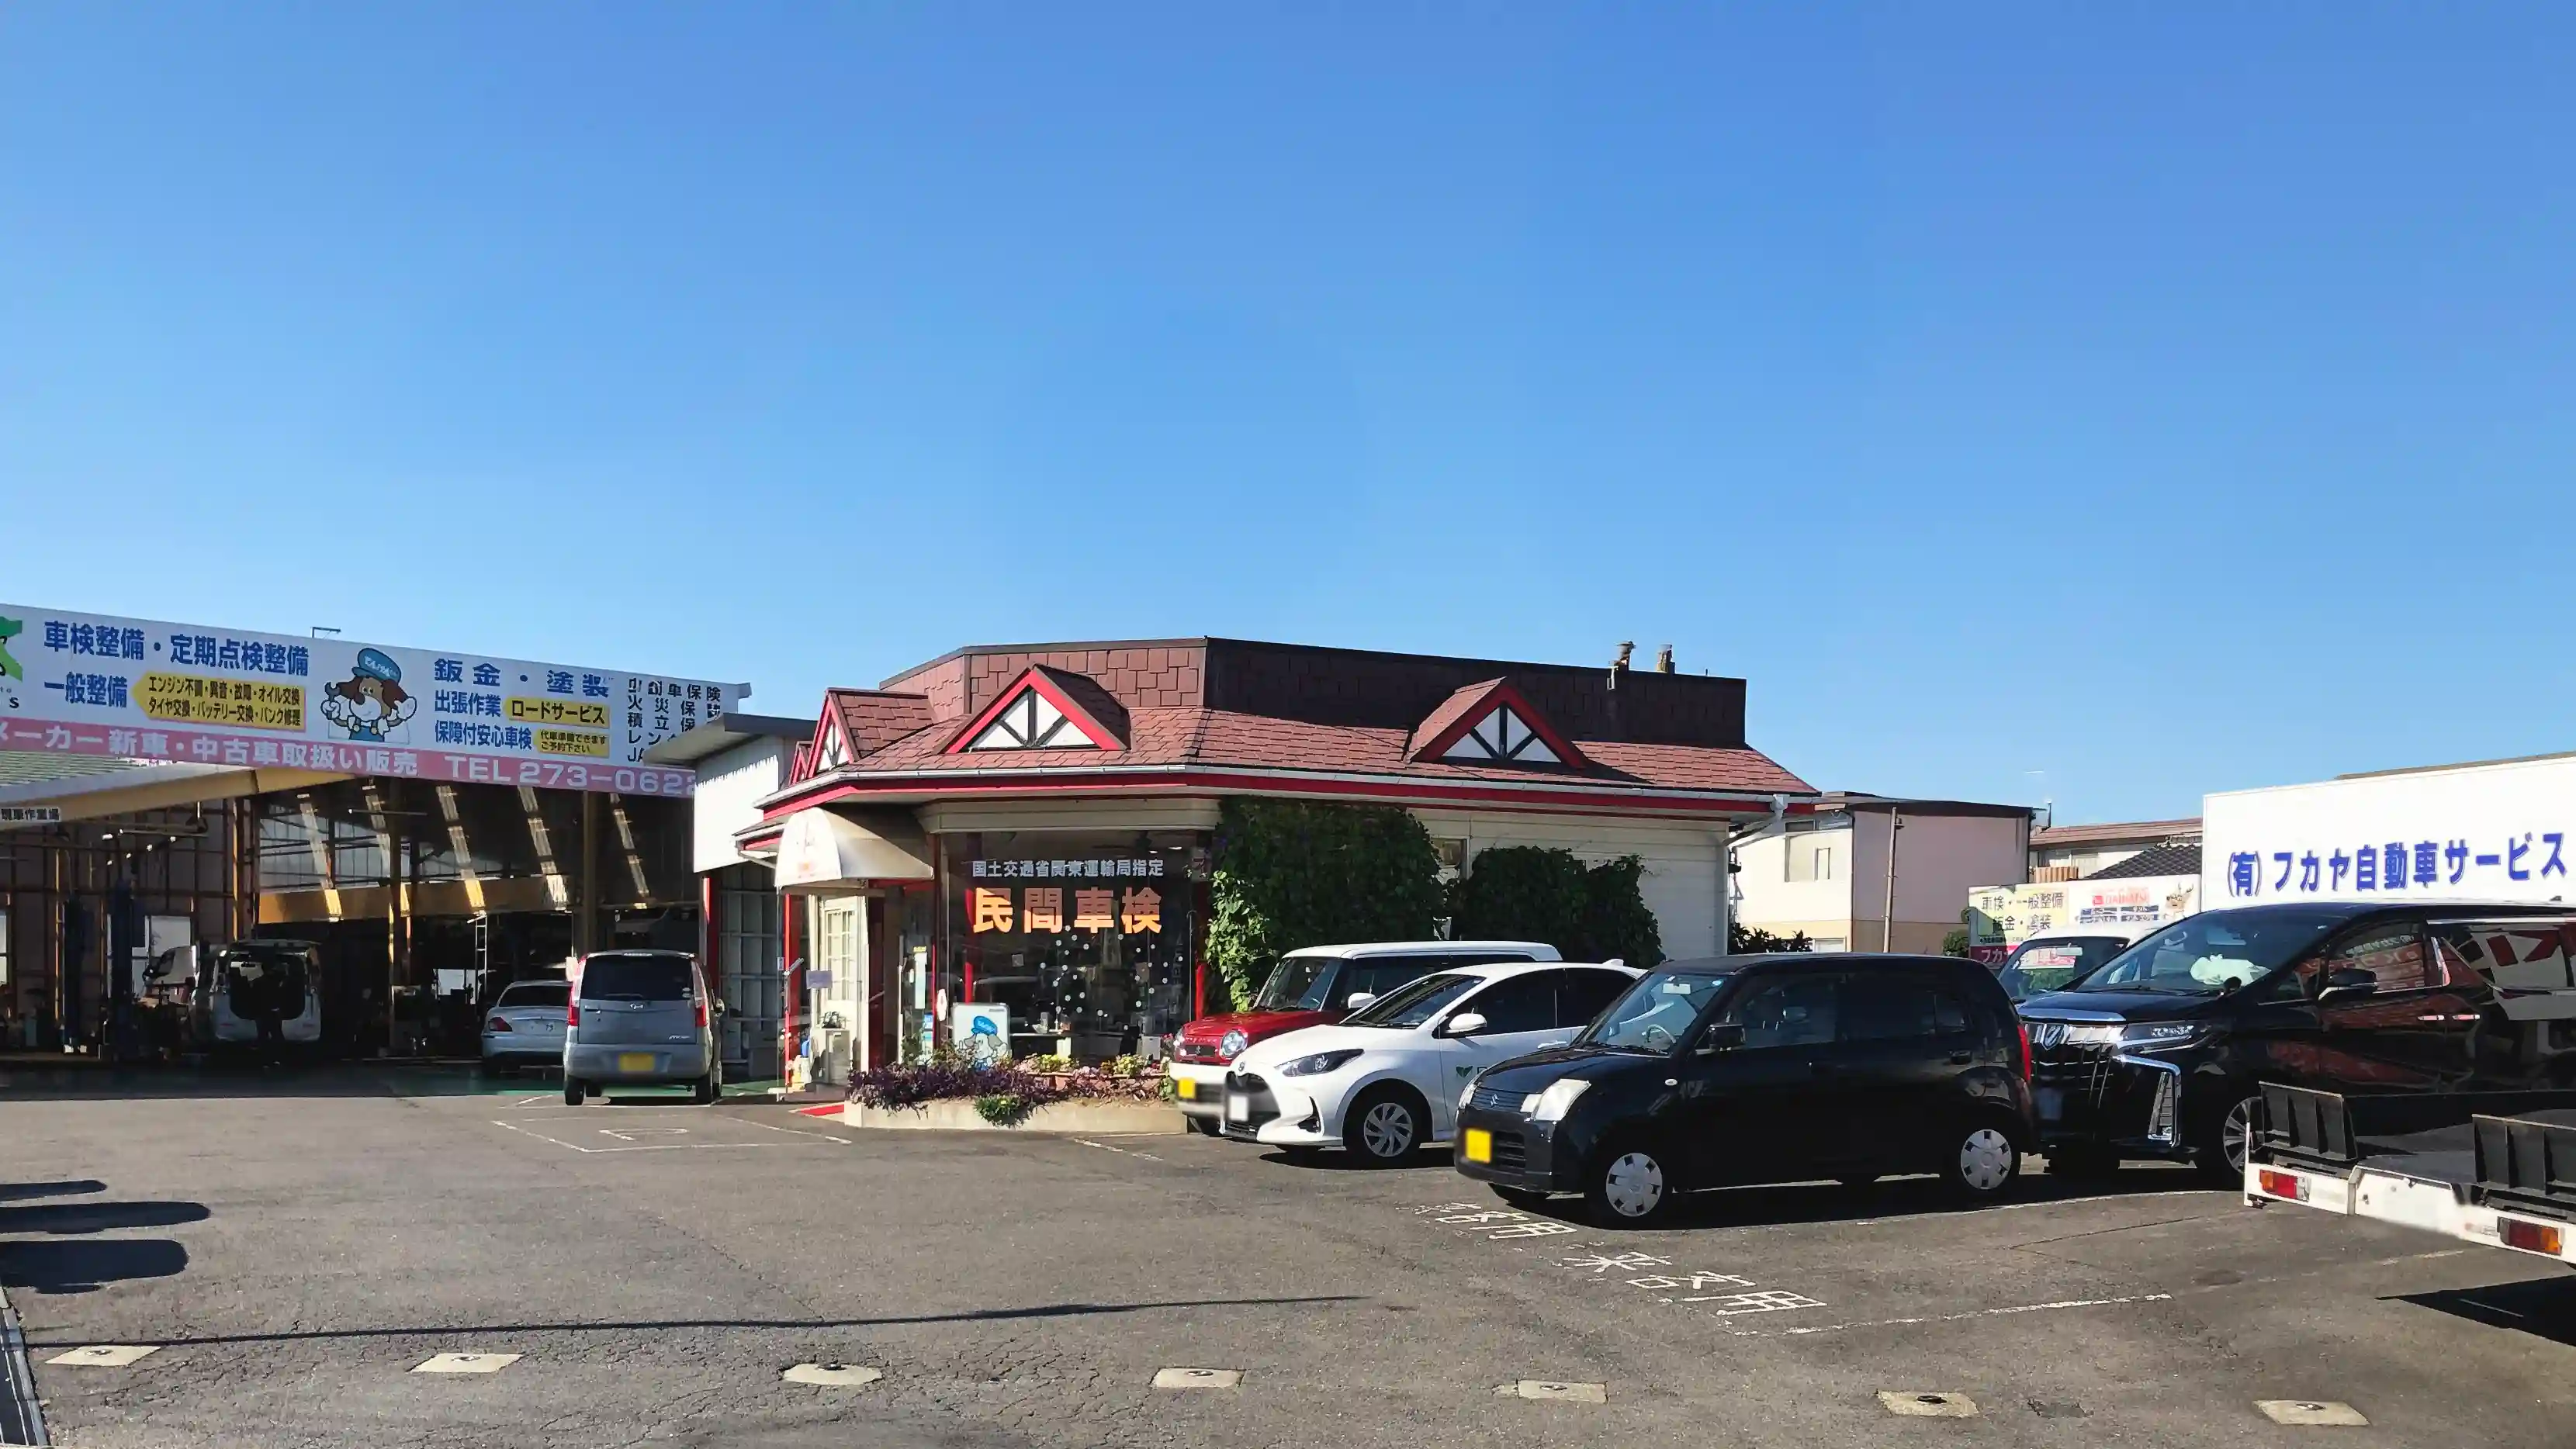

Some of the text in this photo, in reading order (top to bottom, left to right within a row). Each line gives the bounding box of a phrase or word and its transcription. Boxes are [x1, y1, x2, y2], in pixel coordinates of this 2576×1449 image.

[43, 620, 310, 677] 車検整備・定期点検整備
[43, 672, 128, 708] 一般整備
[434, 658, 610, 698] 鈑金・塗装
[434, 690, 501, 718] 出張作業
[511, 700, 605, 724] ロードサービス
[435, 719, 532, 751] 保障付安心車検
[627, 711, 696, 733] 積立保
[628, 729, 677, 745] レン
[445, 756, 511, 781] TEL
[971, 859, 1164, 878] 国土交通省関東運輸局指定
[2228, 832, 2567, 897] (有)フカヤ自動車サービス
[973, 887, 1163, 934] 民間車検
[1982, 891, 2065, 911] 車検・一般整備
